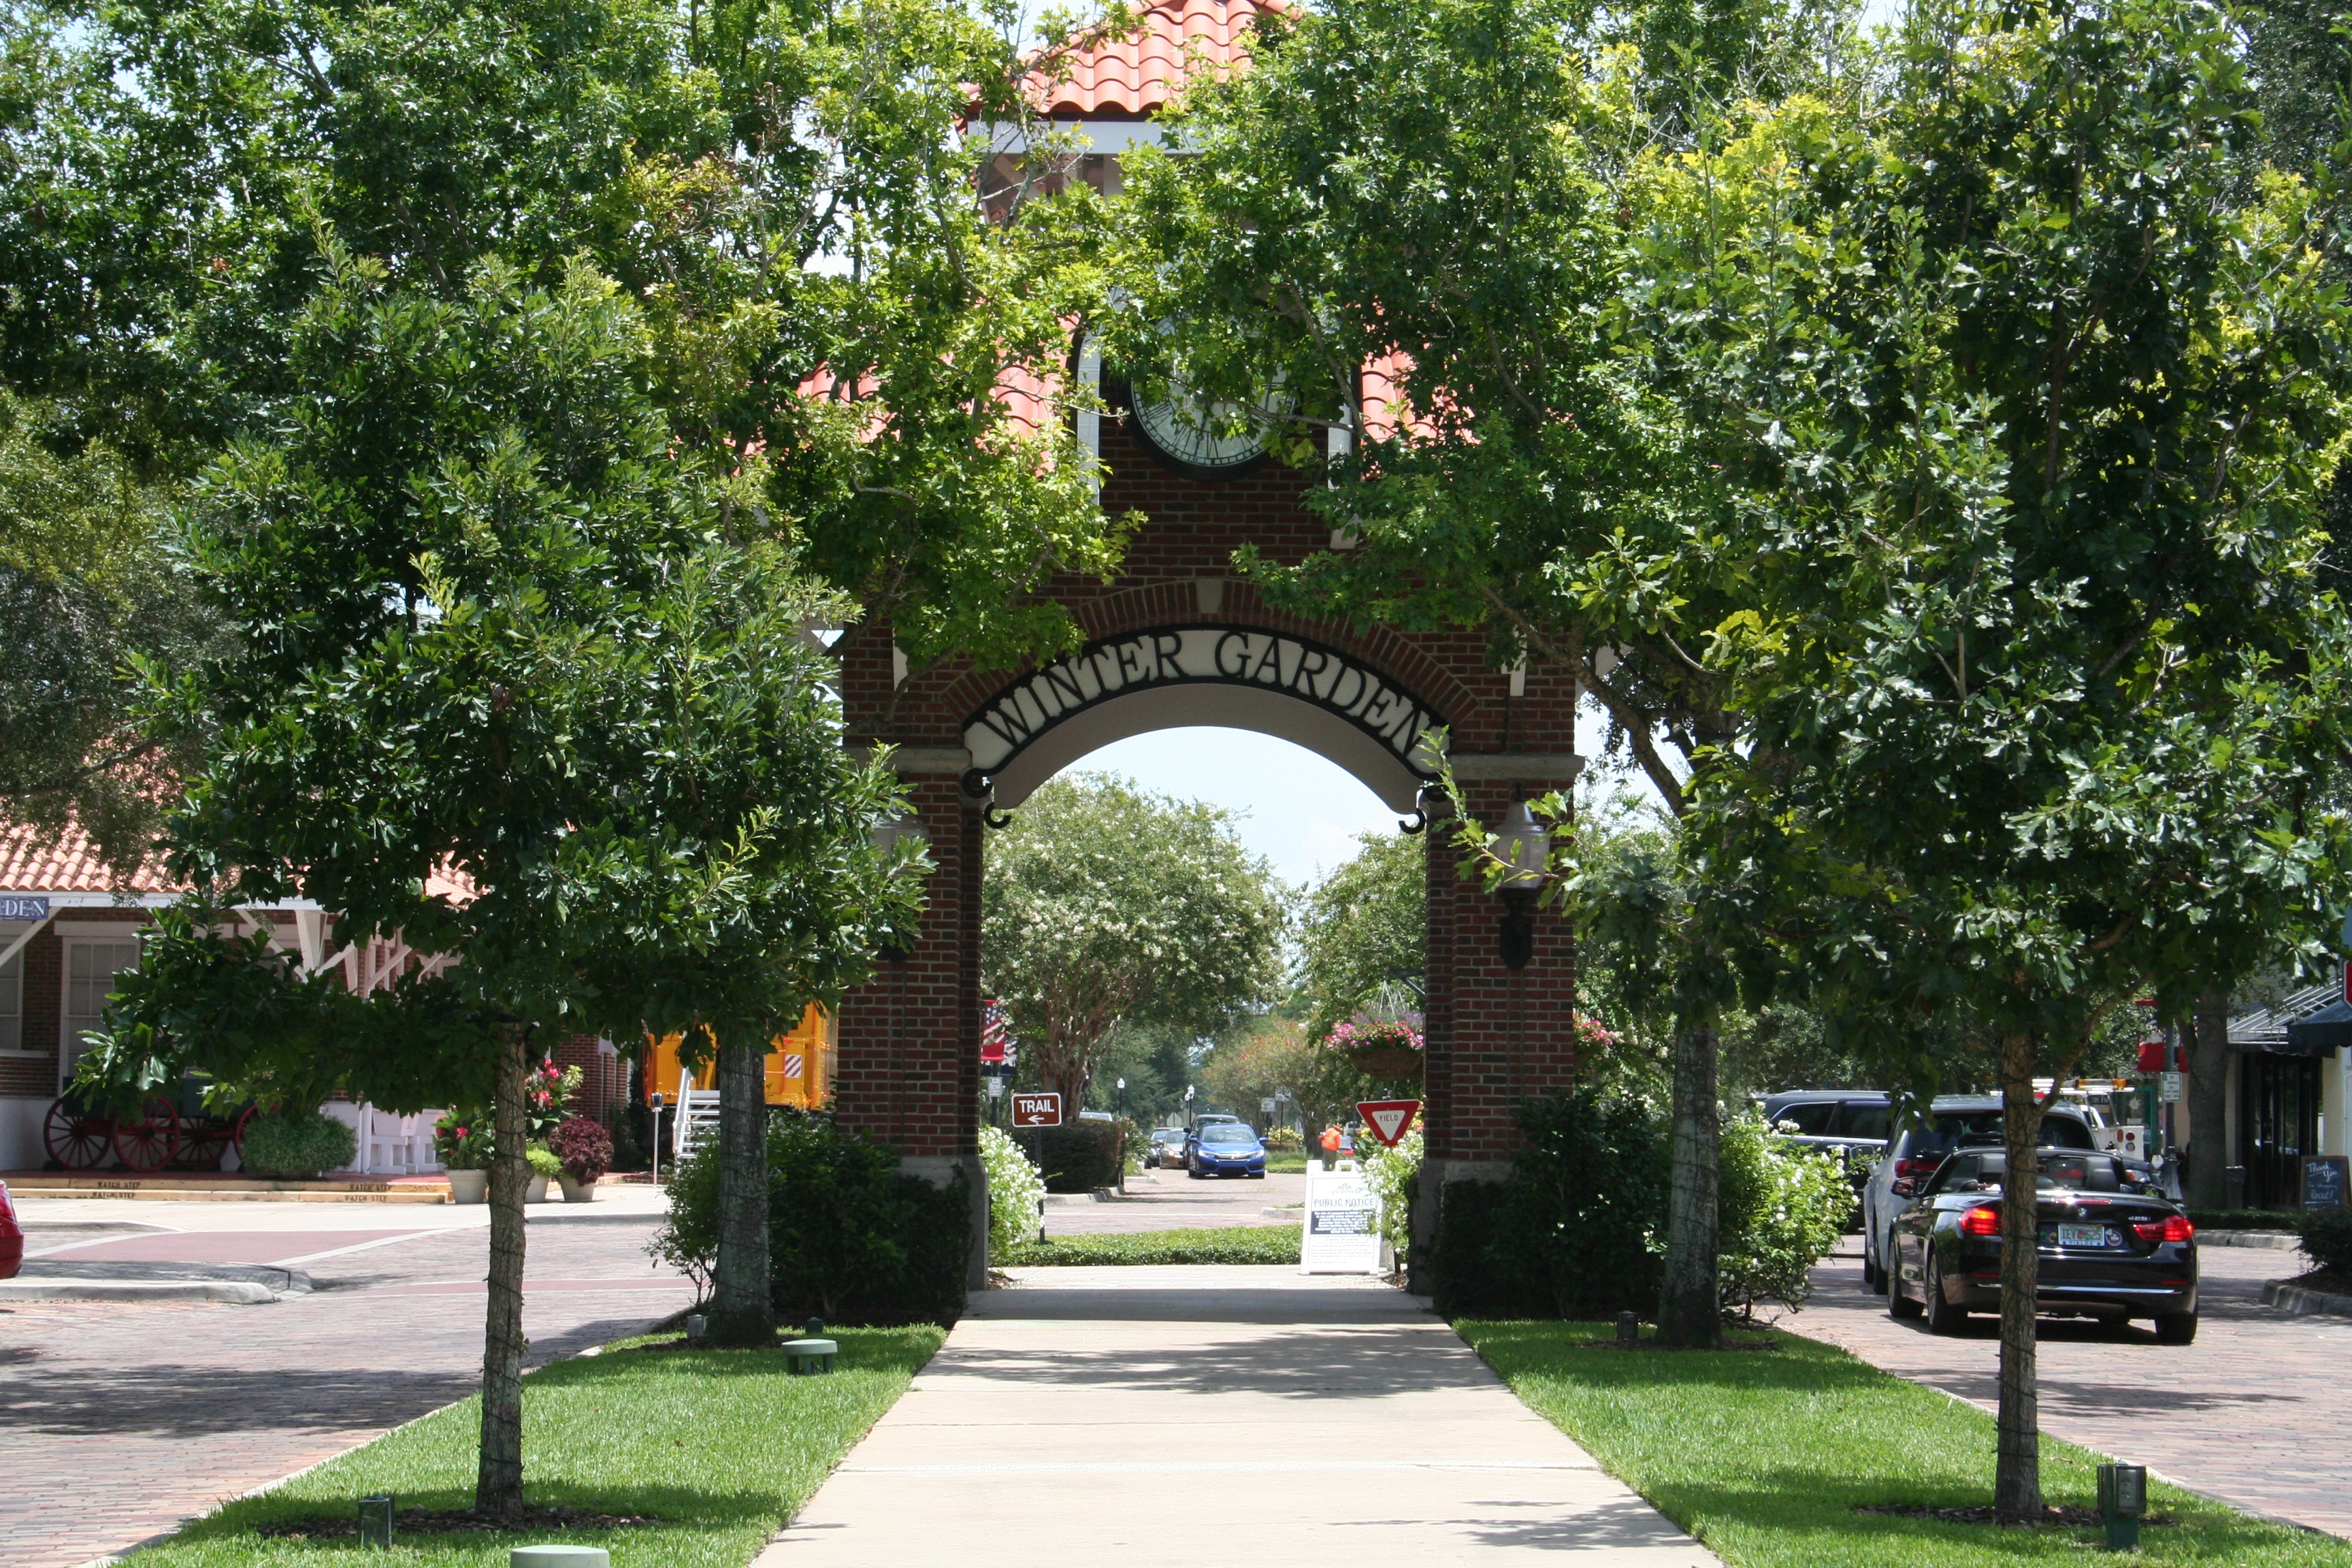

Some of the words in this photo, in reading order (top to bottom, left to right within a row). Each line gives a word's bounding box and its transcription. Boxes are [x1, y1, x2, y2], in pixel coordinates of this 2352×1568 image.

[979, 630, 1190, 749] WINTER
[1214, 630, 1439, 755] GARDEN
[0, 899, 46, 917] DEN
[1018, 1099, 1055, 1113] TRAIL
[1313, 1198, 1343, 1207] PUBLIC
[1345, 1198, 1374, 1207] NOTICE
